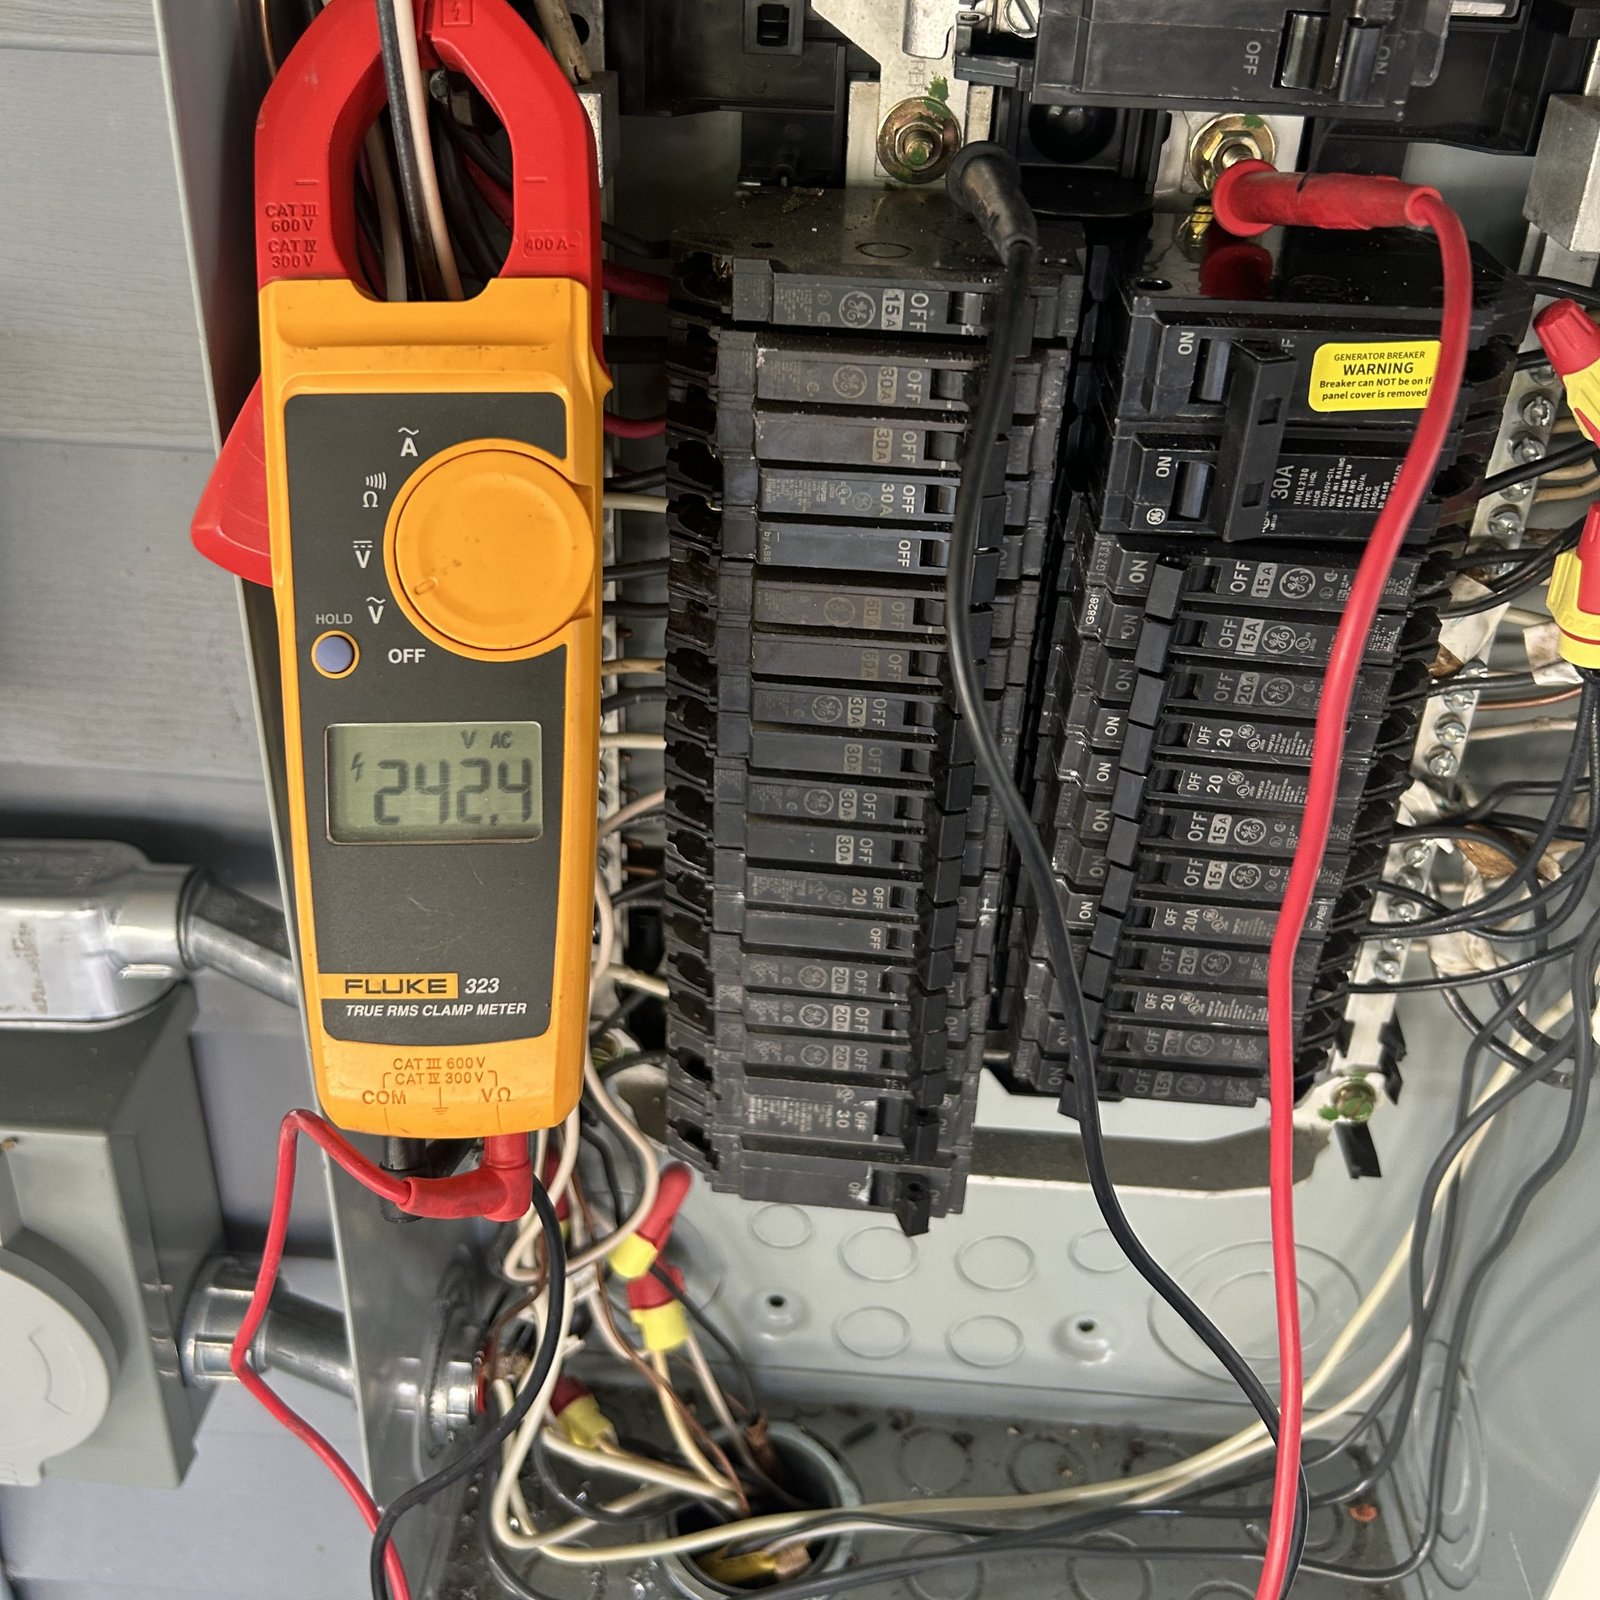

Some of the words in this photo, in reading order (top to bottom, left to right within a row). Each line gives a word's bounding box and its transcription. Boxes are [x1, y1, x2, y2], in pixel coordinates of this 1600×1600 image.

[1243, 41, 1261, 76] OFF
[265, 203, 297, 218] CAT
[301, 203, 319, 217] III
[271, 219, 300, 232] 600
[302, 218, 314, 232] V
[268, 239, 300, 253] CAT
[303, 239, 318, 253] IV
[525, 238, 554, 251] 400
[271, 255, 301, 269] 300
[303, 254, 314, 267] V
[884, 293, 902, 329] 15A
[910, 293, 930, 332] OFF
[1177, 331, 1195, 355] ON
[1334, 352, 1386, 362] GENERATOR
[1386, 351, 1426, 360] BREAKER
[1343, 362, 1414, 376] WARNING
[879, 368, 895, 400] 30A
[906, 370, 922, 404] OFF
[1319, 379, 1356, 389] Breaker
[1357, 380, 1374, 388] can
[1376, 378, 1396, 386] NOT
[1398, 377, 1410, 386] be
[1425, 377, 1433, 385] if
[1322, 390, 1349, 401] panel
[1350, 391, 1376, 399] cover
[1377, 389, 1385, 398] is
[1387, 389, 1428, 398] removed
[875, 430, 890, 460] 30A
[901, 431, 918, 464] OFF
[1155, 456, 1172, 478] ON
[1270, 465, 1295, 500] 30A
[880, 483, 895, 516] 30A
[902, 484, 916, 514] OFF
[897, 539, 911, 568] OFF
[1128, 559, 1149, 583] ON
[1229, 560, 1250, 593] OFF
[1256, 566, 1273, 594] 15A
[315, 613, 353, 625] HOLD
[1121, 614, 1139, 637] ON
[1218, 618, 1238, 648] OFF
[1241, 622, 1260, 649] 15A
[387, 648, 426, 664] OFF
[887, 653, 902, 681] OFF
[1115, 668, 1133, 691] ON
[1213, 672, 1235, 701] OFF
[850, 696, 864, 724] 30A
[871, 698, 887, 727] OFF
[1104, 716, 1121, 736] ON
[1196, 726, 1212, 745] OFF
[460, 730, 478, 749] V
[490, 731, 513, 749] AC
[1216, 728, 1234, 748] 20
[868, 746, 883, 774] OFF
[1096, 762, 1112, 782] ON
[1187, 772, 1202, 791] OFF
[373, 757, 533, 827] 242.4
[1206, 774, 1224, 794] 20
[841, 790, 855, 818] 30A
[862, 792, 878, 820] OFF
[1092, 809, 1111, 832] ON
[1187, 812, 1208, 842] OFF
[1211, 816, 1228, 842] 15A
[838, 836, 852, 862] 30A
[859, 837, 873, 864] OFF
[1089, 855, 1106, 878] ON
[1183, 858, 1204, 887] OFF
[1207, 863, 1224, 887] 15A
[851, 887, 867, 905] 20
[872, 886, 884, 909] OFF
[1078, 901, 1094, 919] ON
[1163, 907, 1178, 926] OFF
[1182, 908, 1200, 932] 20A
[869, 927, 881, 950] OFF
[1158, 947, 1176, 973] OFF
[344, 978, 448, 994] FLUKE
[465, 977, 501, 994] 323
[854, 969, 868, 995] OFF
[346, 1005, 384, 1017] TRUE
[387, 1005, 419, 1017] RMS
[422, 1003, 474, 1016] CLAMP
[476, 1002, 527, 1015] METER
[1144, 992, 1158, 1010] OFF
[1160, 994, 1176, 1012] 20
[854, 1007, 870, 1034] OFF
[944, 1016, 959, 1036] ON
[1143, 1029, 1161, 1053] OFF
[393, 1058, 424, 1070] CAT
[426, 1058, 442, 1070] III
[446, 1057, 473, 1069] 600
[476, 1057, 486, 1068] V
[854, 1048, 868, 1072] OFF
[395, 1072, 425, 1085] CAT
[428, 1072, 441, 1084] IV
[445, 1072, 470, 1084] 300
[473, 1071, 484, 1083] V
[1047, 1067, 1065, 1086] ON
[1134, 1070, 1151, 1094] OFF
[362, 1090, 407, 1105] COM
[836, 1109, 851, 1128] 30
[854, 1111, 868, 1132] OFF
